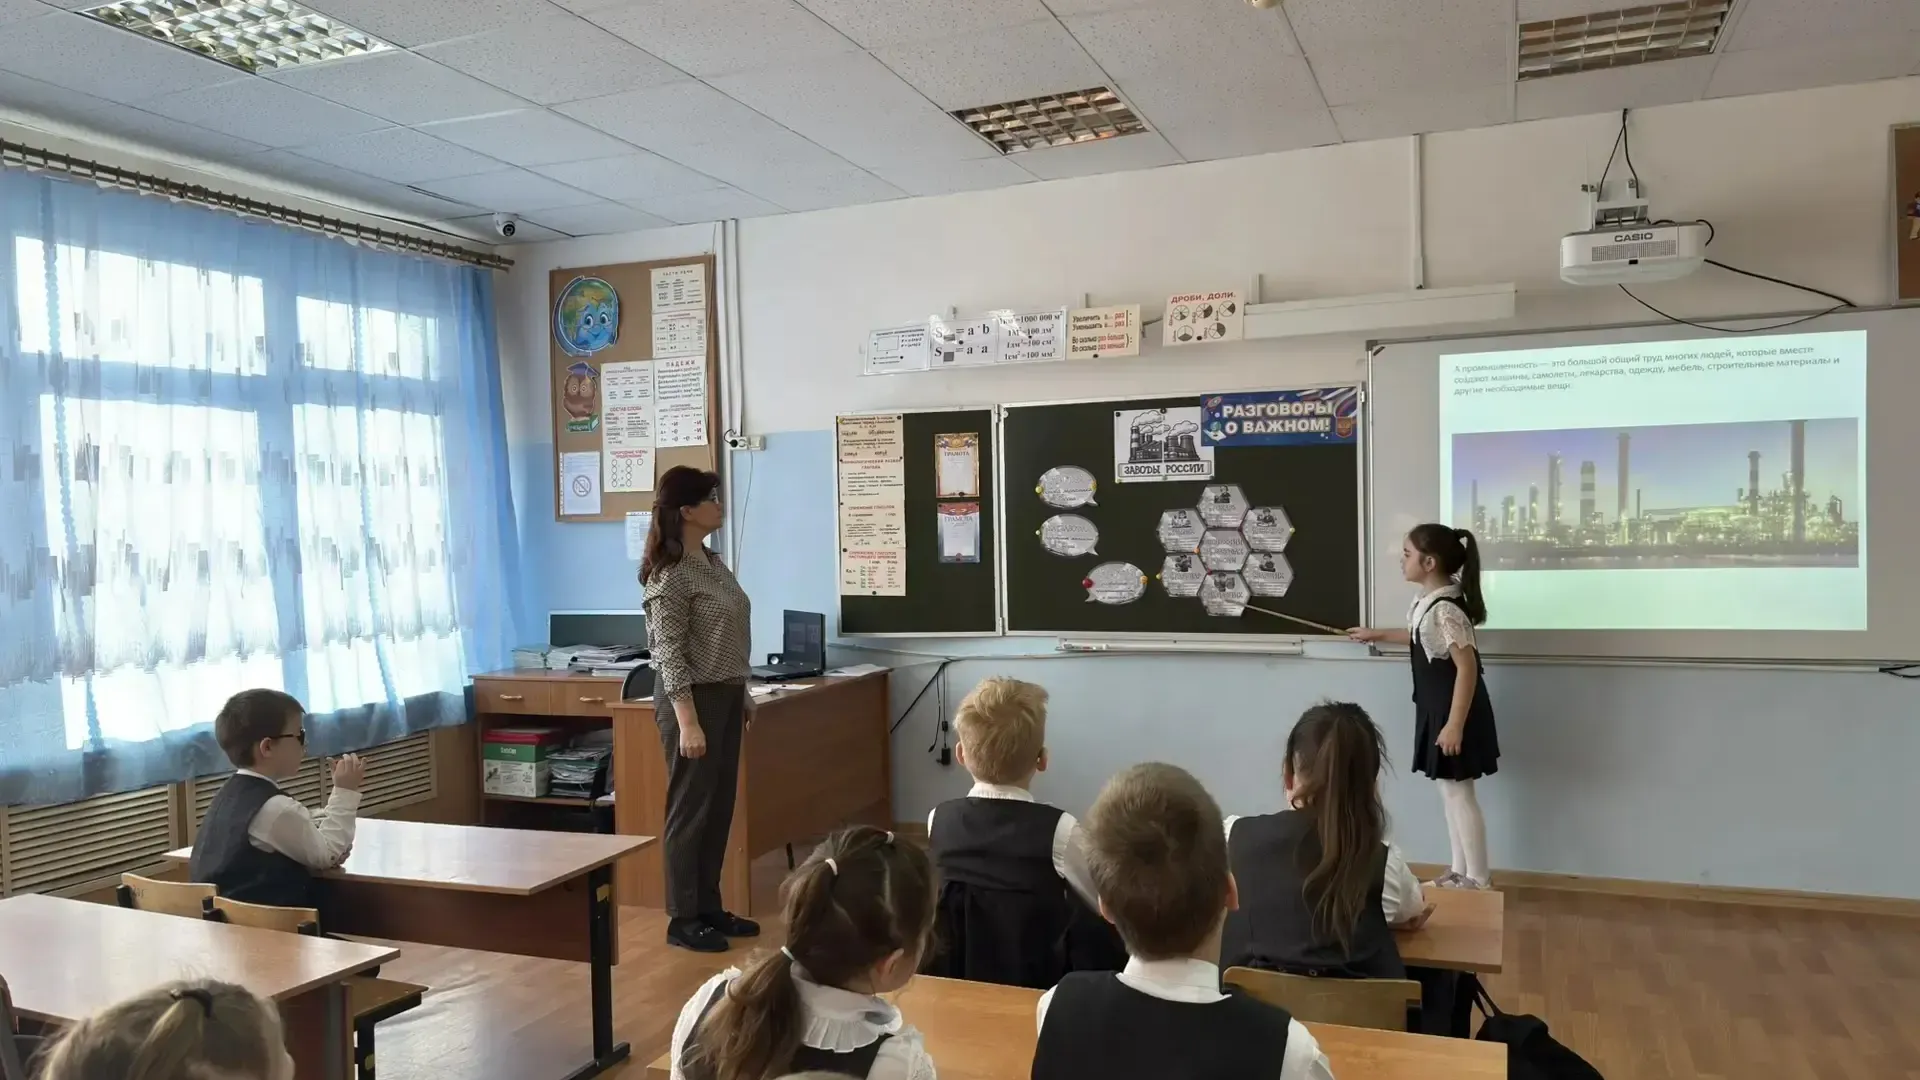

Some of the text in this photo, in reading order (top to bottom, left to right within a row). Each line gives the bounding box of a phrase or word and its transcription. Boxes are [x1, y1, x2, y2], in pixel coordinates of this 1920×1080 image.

[1614, 232, 1653, 242] CASIO
[1171, 292, 1236, 304] ДРОБИ, ДОЛИ.
[1462, 362, 1538, 374] промышленность
[1568, 356, 1608, 367] большой
[1609, 354, 1640, 364] общий
[1644, 355, 1663, 364] труд
[1665, 352, 1698, 361] многих
[1736, 348, 1777, 357] которые
[1708, 360, 1774, 372] строительные
[1222, 400, 1334, 418] РАЗГОВОРЫ
[1225, 418, 1331, 434] О ВАЖНОМ!
[1124, 462, 1205, 476] ЗАВОДЫ РОССИИ
